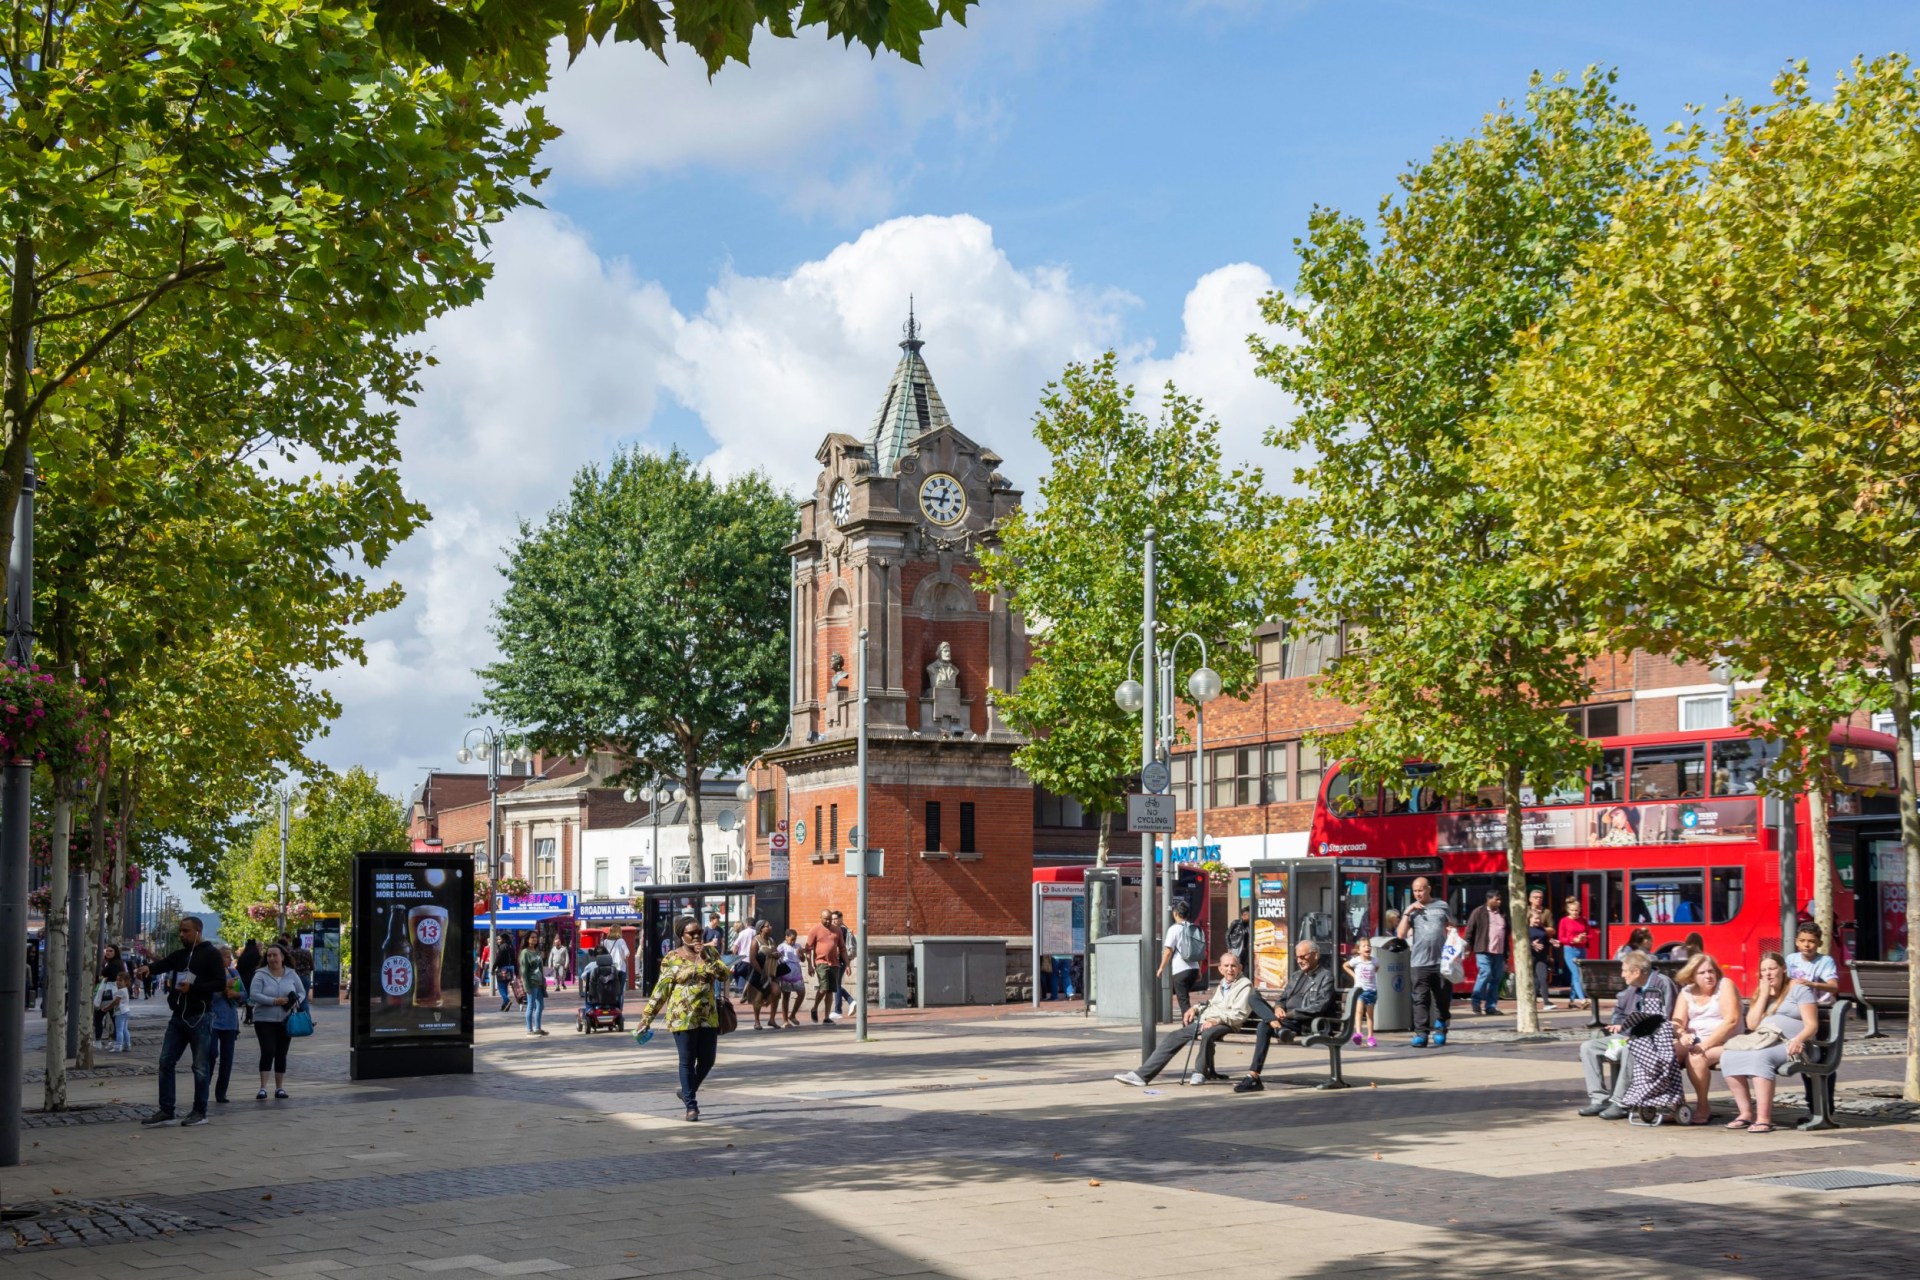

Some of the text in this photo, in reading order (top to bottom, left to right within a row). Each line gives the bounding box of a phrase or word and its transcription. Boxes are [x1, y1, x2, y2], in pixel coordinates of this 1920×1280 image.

[1137, 816, 1168, 824] CYCLING
[1328, 843, 1367, 853] Stagecoach
[1397, 862, 1407, 871] 96
[376, 873, 415, 881] MORE HOPS.
[396, 882, 416, 890] TASTE.
[376, 890, 434, 898] MORE CHARACTER.
[1265, 898, 1285, 907] MAKE
[580, 905, 635, 915] BROADWAY NEWS
[1258, 907, 1285, 917] LUNCH
[420, 926, 438, 938] 13
[384, 968, 409, 986] 13
